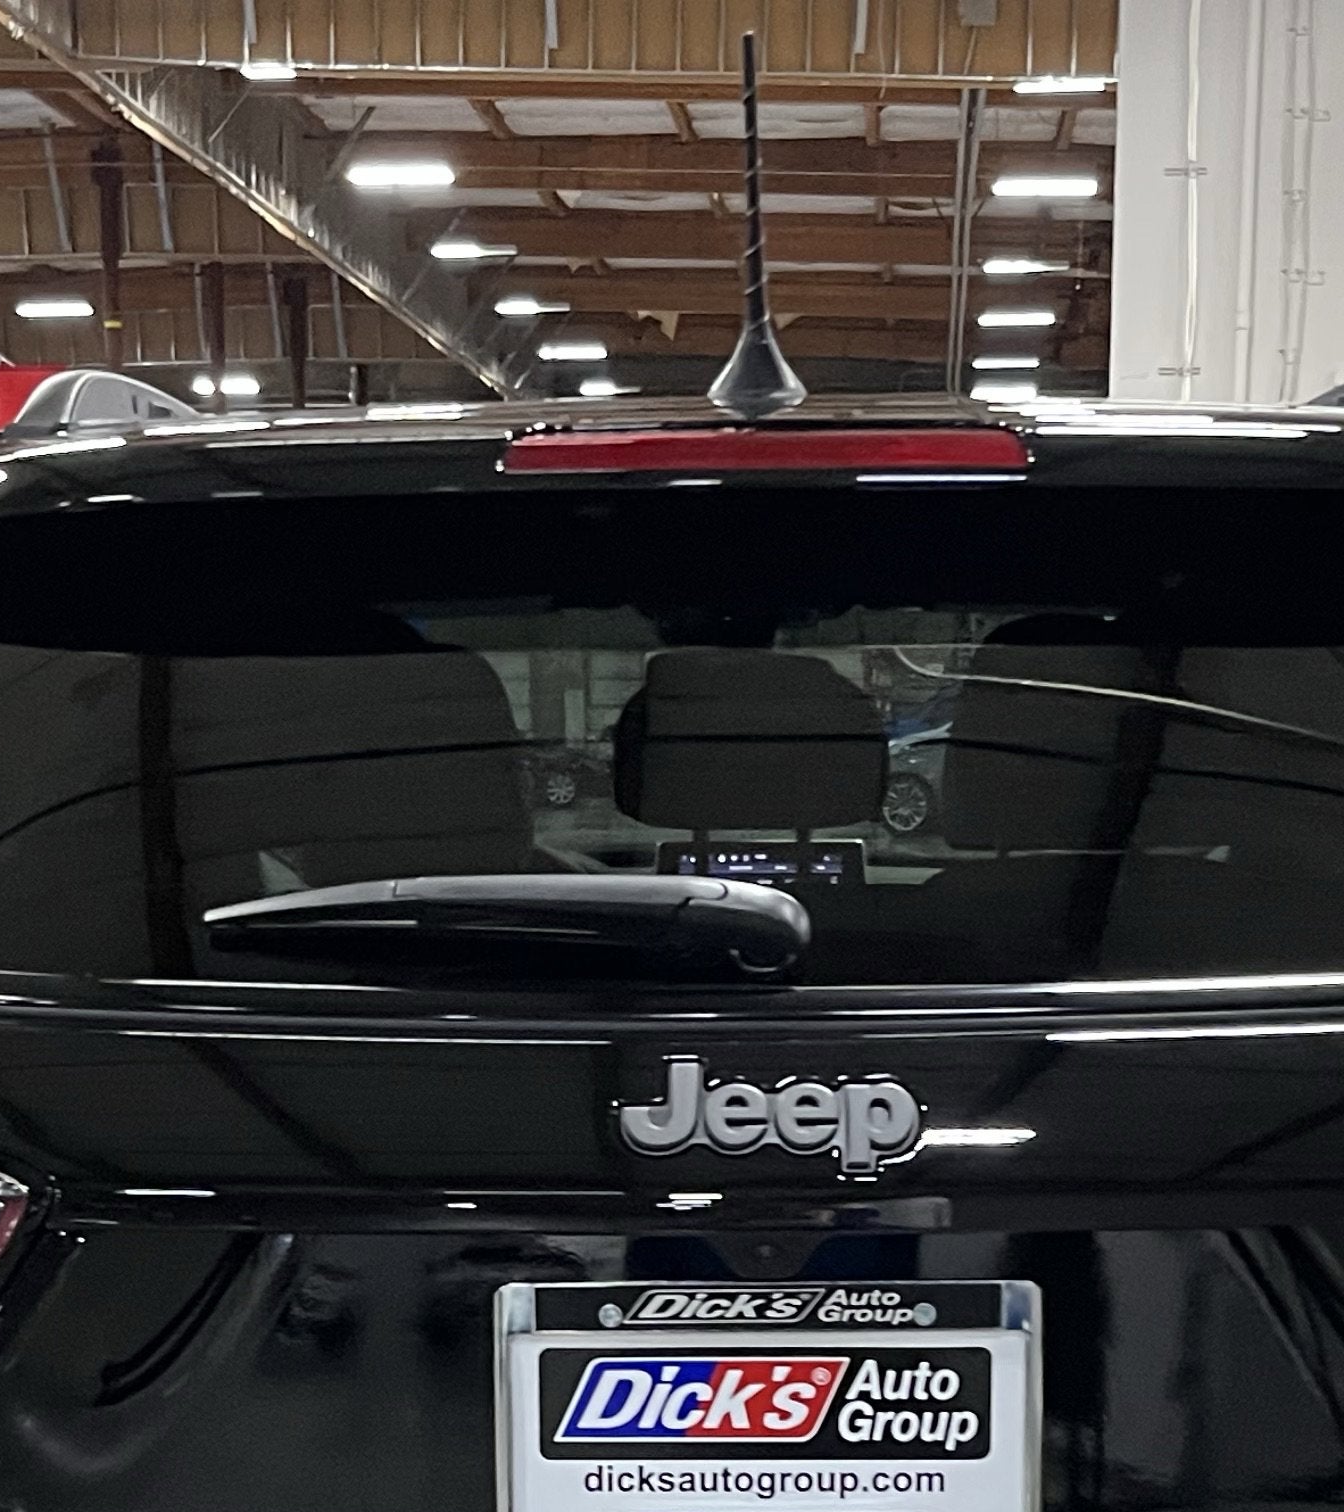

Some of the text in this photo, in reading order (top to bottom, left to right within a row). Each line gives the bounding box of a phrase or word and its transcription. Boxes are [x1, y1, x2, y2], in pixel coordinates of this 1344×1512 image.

[619, 1054, 921, 1174] Jeep
[637, 1288, 902, 1319] Dick's Auto
[816, 1304, 915, 1326] Group
[575, 1359, 961, 1430] Dick's Auto
[837, 1402, 980, 1451] Group
[584, 1465, 946, 1499] dicksautogroup.com
